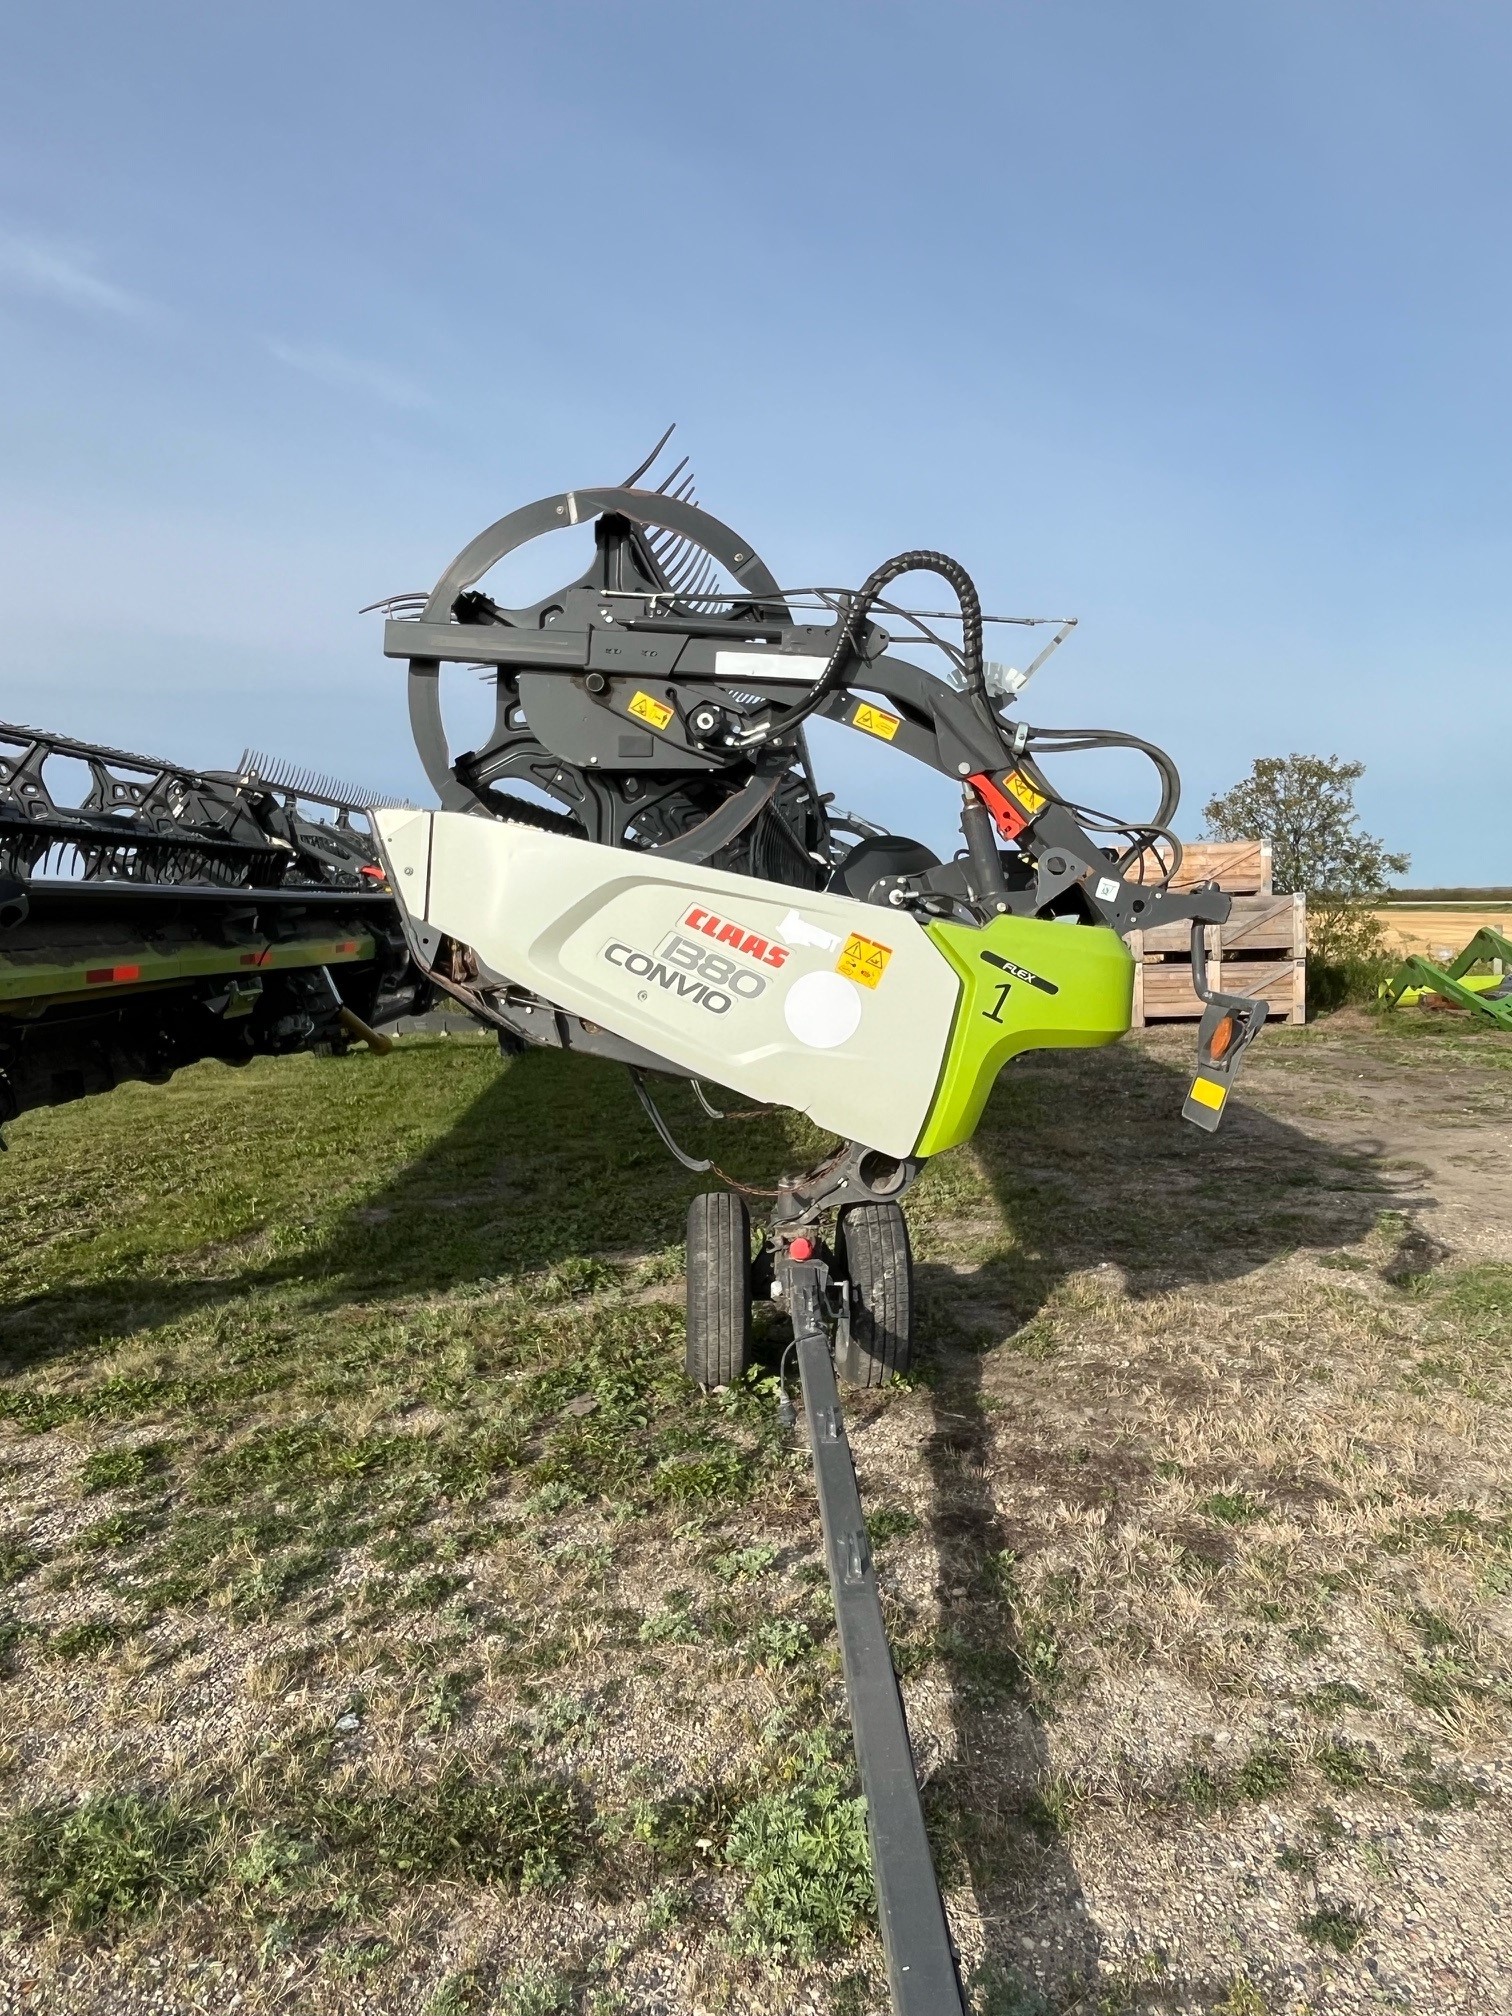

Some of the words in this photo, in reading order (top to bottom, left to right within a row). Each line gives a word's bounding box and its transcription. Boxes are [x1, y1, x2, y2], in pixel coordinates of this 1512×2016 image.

[684, 908, 790, 968] CLAAS
[604, 943, 732, 1014] CONVIO
[1003, 963, 1036, 983] FLEX
[982, 984, 1012, 1024] 1
